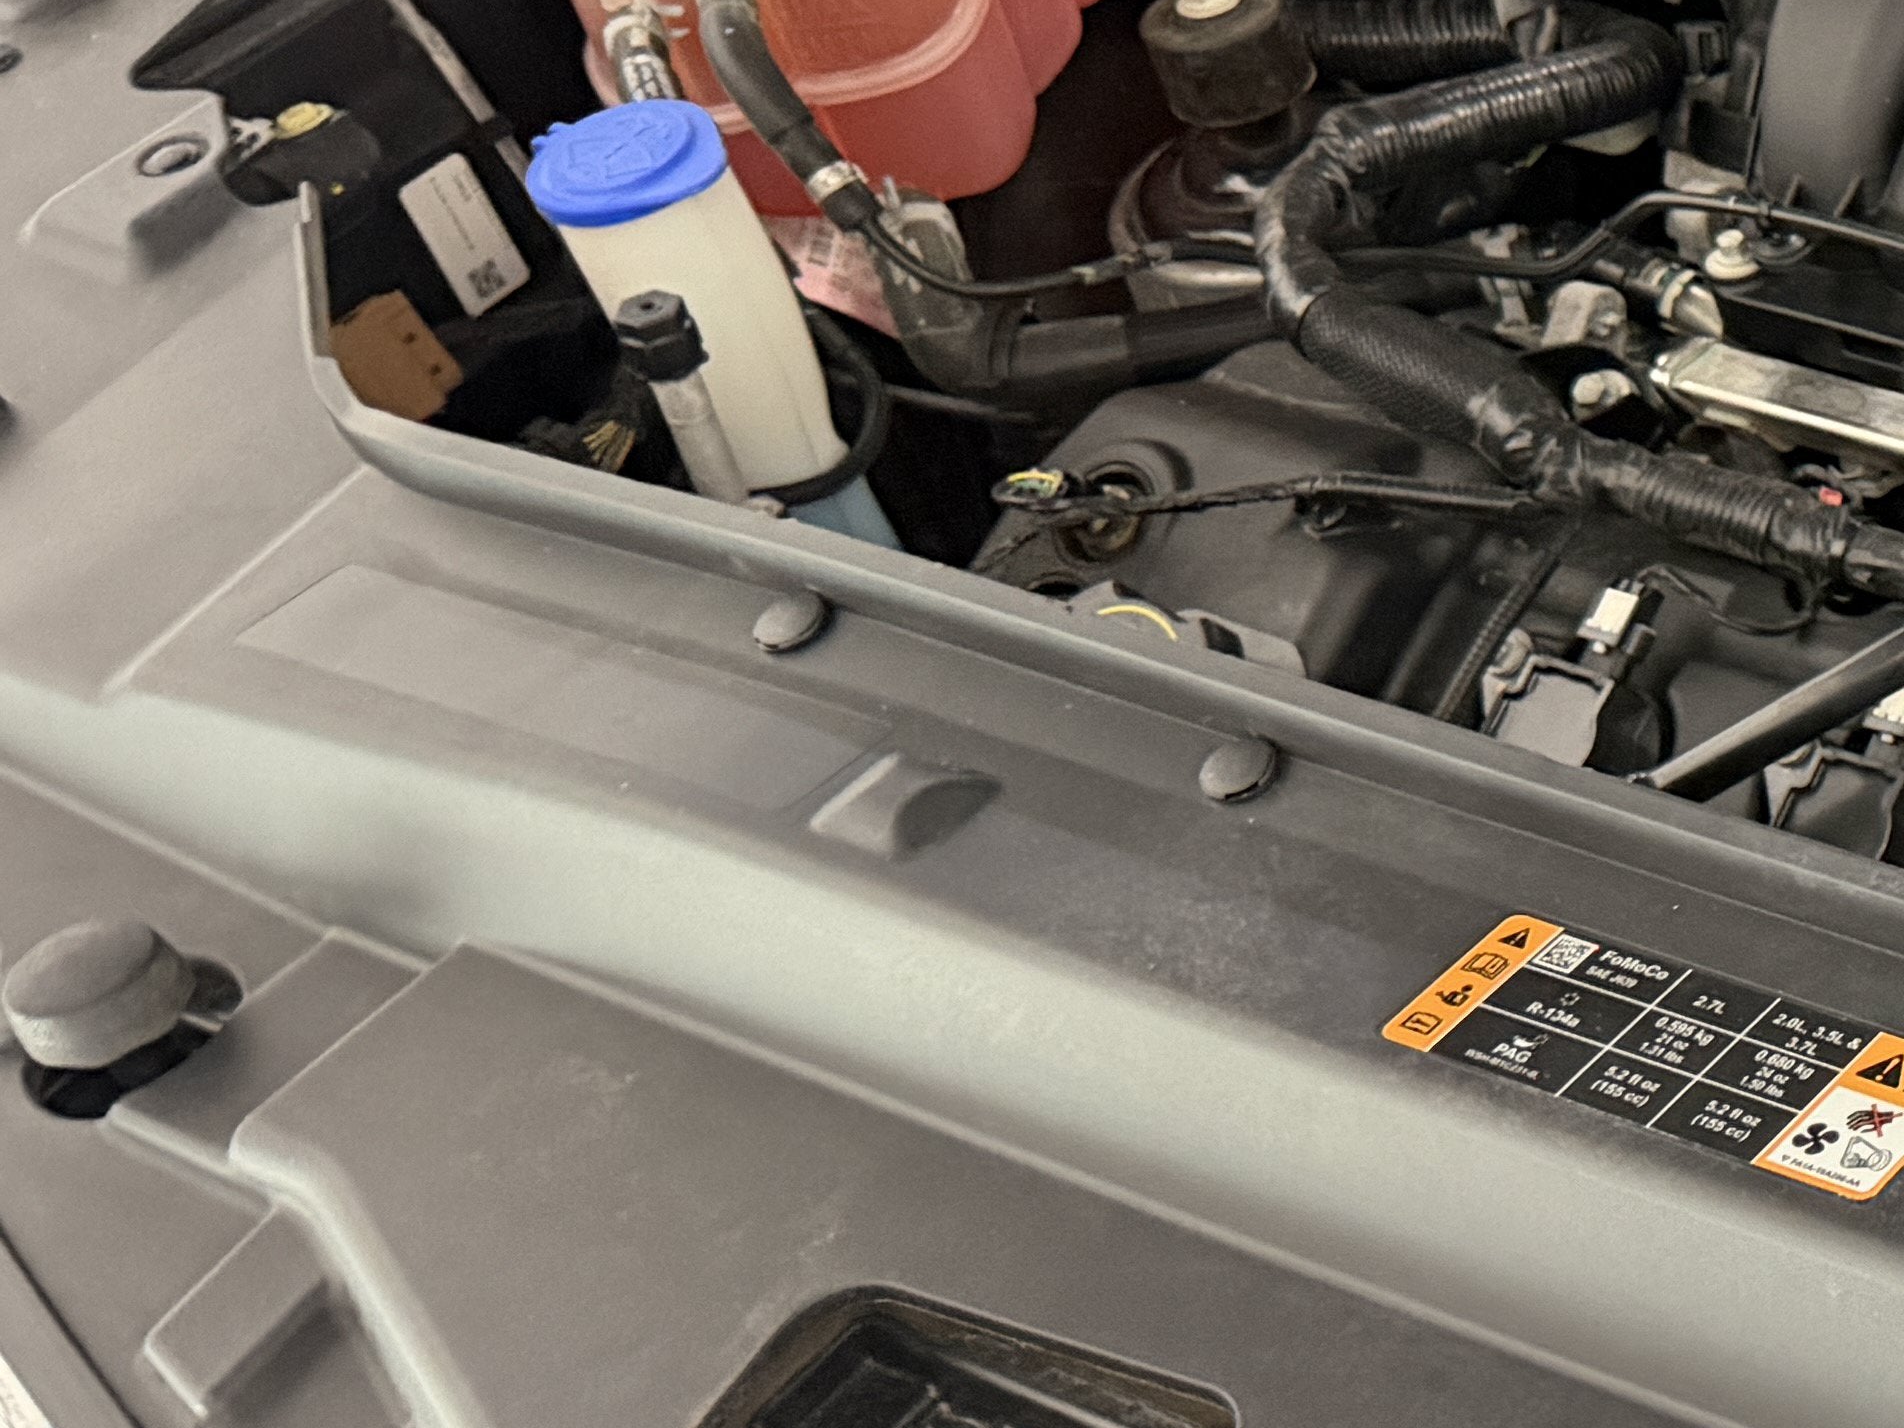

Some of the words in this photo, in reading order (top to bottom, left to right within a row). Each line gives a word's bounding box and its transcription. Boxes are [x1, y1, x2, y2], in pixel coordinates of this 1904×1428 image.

[1598, 949, 1670, 981] FoMoCo
[1525, 1000, 1581, 1028] R-134a
[1692, 995, 1726, 1015] 2.7L
[1654, 1016, 1698, 1038] 0.595
[1692, 1029, 1715, 1047] kg
[1654, 1032, 1675, 1046] 21
[1672, 1040, 1690, 1051] oz
[1811, 1026, 1845, 1046] 3.5L
[1846, 1037, 1863, 1051] &
[1491, 1042, 1533, 1064] PAG
[1638, 1041, 1666, 1058] 1.31
[1662, 1050, 1685, 1064] lbs
[1784, 1036, 1818, 1057] 3.7L
[1754, 1049, 1796, 1071] 0.680
[1792, 1062, 1816, 1081] kg
[1754, 1066, 1775, 1079] 24
[1772, 1073, 1790, 1085] oz
[1603, 1065, 1631, 1081] 5.2
[1640, 1080, 1661, 1093] oz
[1739, 1075, 1767, 1092] 1.50
[1762, 1083, 1786, 1098] lbs
[1589, 1079, 1627, 1098] (155
[1623, 1092, 1650, 1108] cc)
[1704, 1099, 1731, 1116] 5.2
[1740, 1114, 1762, 1128] oz
[1690, 1113, 1728, 1132] (155
[1724, 1126, 1752, 1143] cc)
